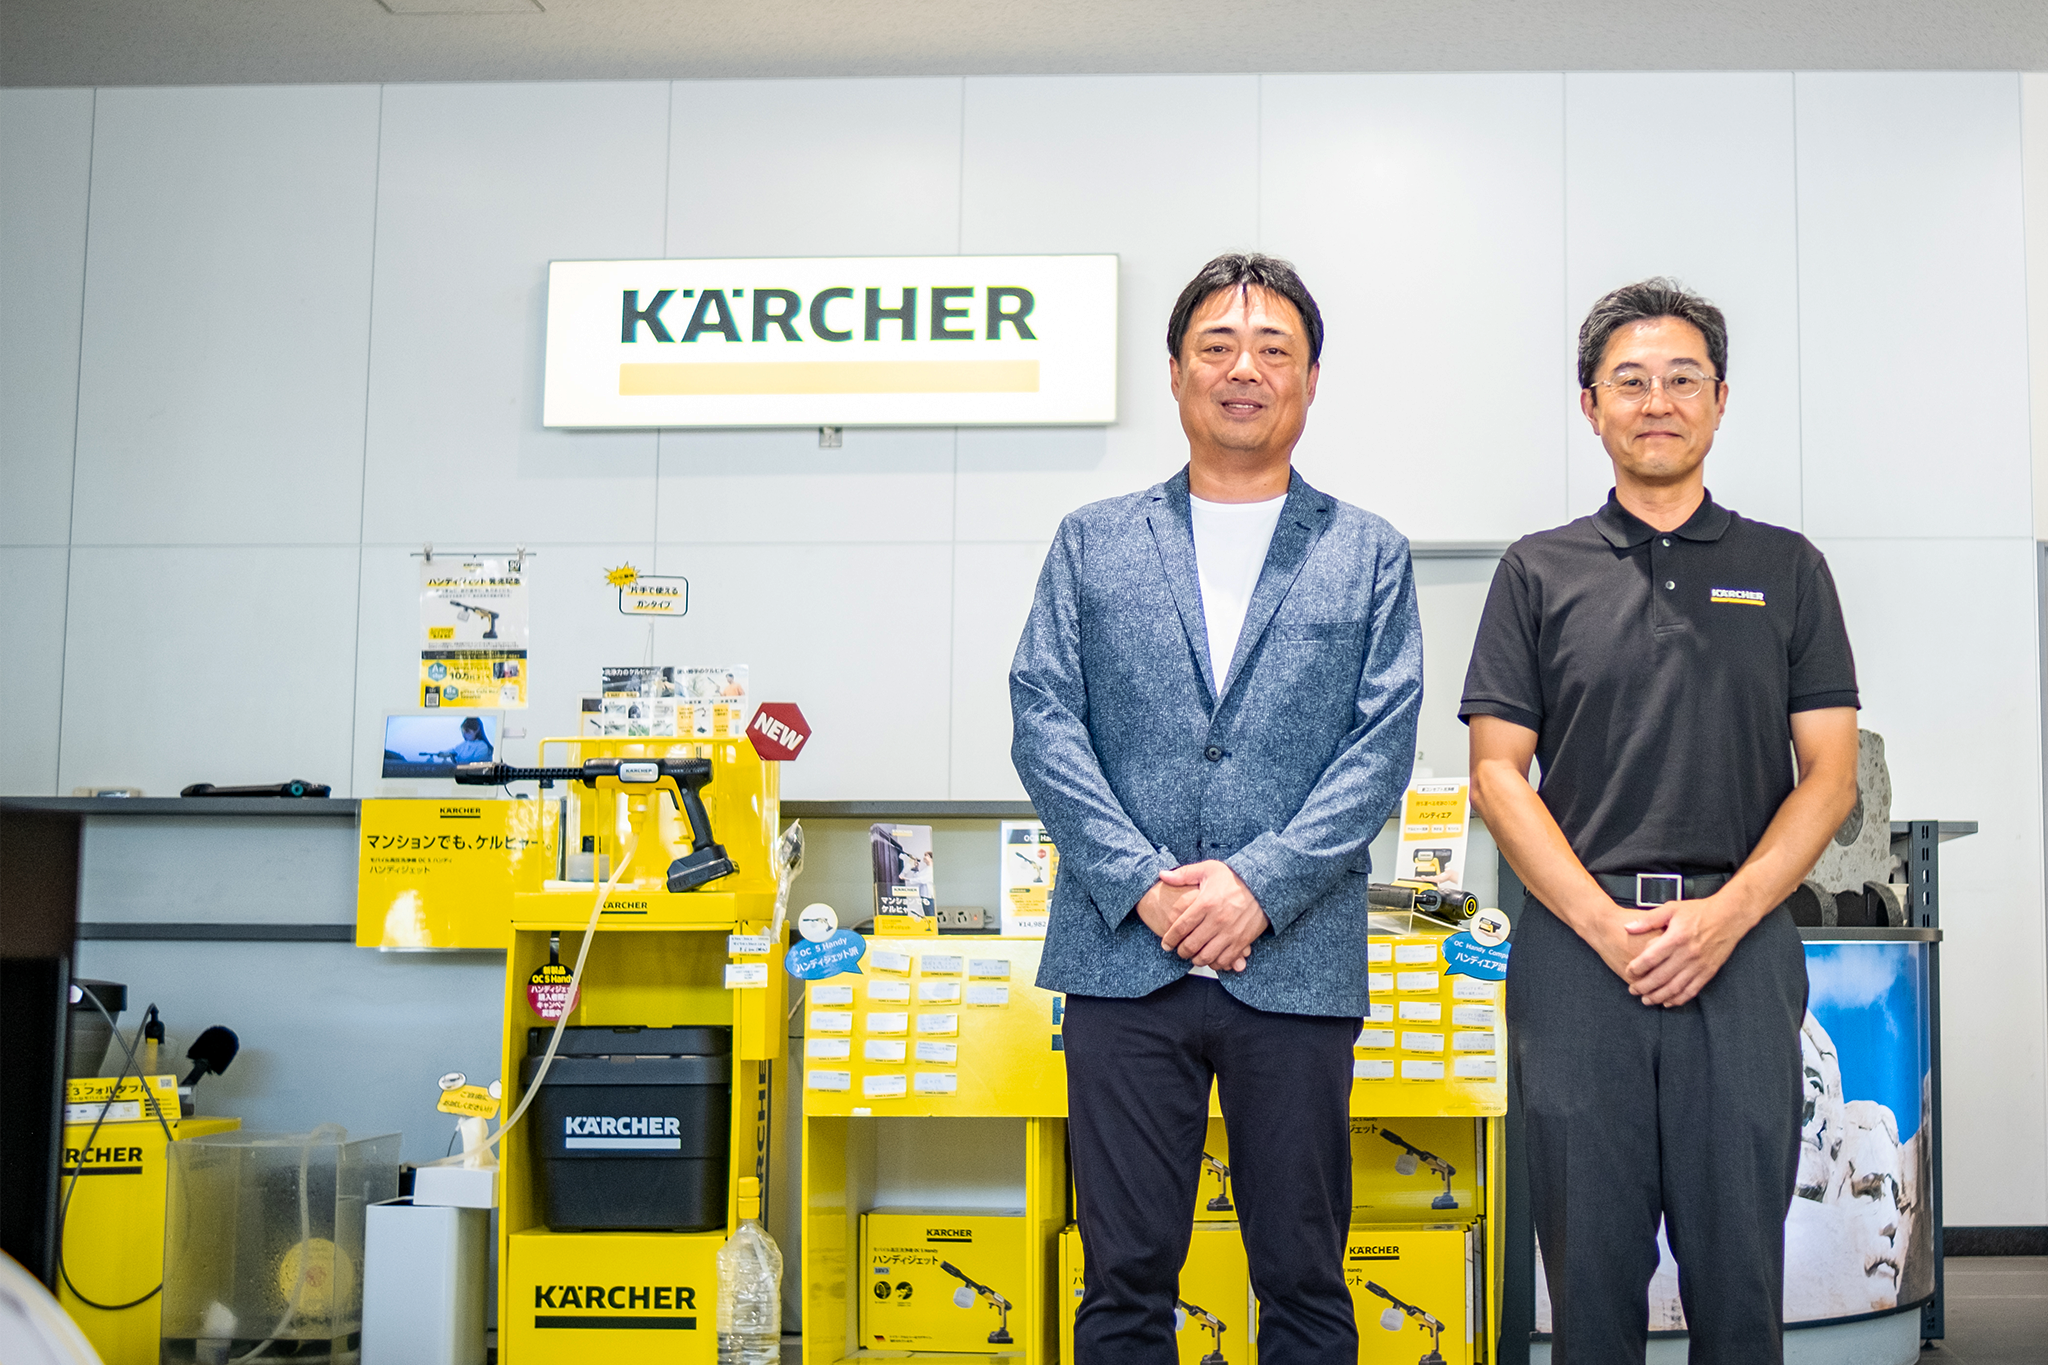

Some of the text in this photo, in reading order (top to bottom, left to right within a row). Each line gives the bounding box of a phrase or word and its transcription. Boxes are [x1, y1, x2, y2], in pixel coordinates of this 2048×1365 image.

[621, 286, 1038, 343] KÄRCHER
[630, 586, 679, 596] 片手で使える
[637, 600, 672, 609] ガンタイプ
[753, 711, 804, 751] NEW
[1418, 811, 1453, 819] ハンディエア
[369, 865, 431, 875] ハンディジェット
[799, 947, 813, 958] OC
[822, 936, 848, 951] Handy
[1453, 940, 1464, 948] OC
[1465, 943, 1486, 954] Handy
[794, 945, 860, 973] ハンディジェット派
[532, 974, 544, 984] OC
[565, 1116, 681, 1135] KÄRCHER
[65, 1147, 143, 1163] RCHER
[926, 1228, 972, 1237] KÄRCHER
[1349, 1246, 1399, 1255] KÄRCHER
[873, 1254, 939, 1266] ハンディジェット
[535, 1285, 697, 1310] KÄRCHER
